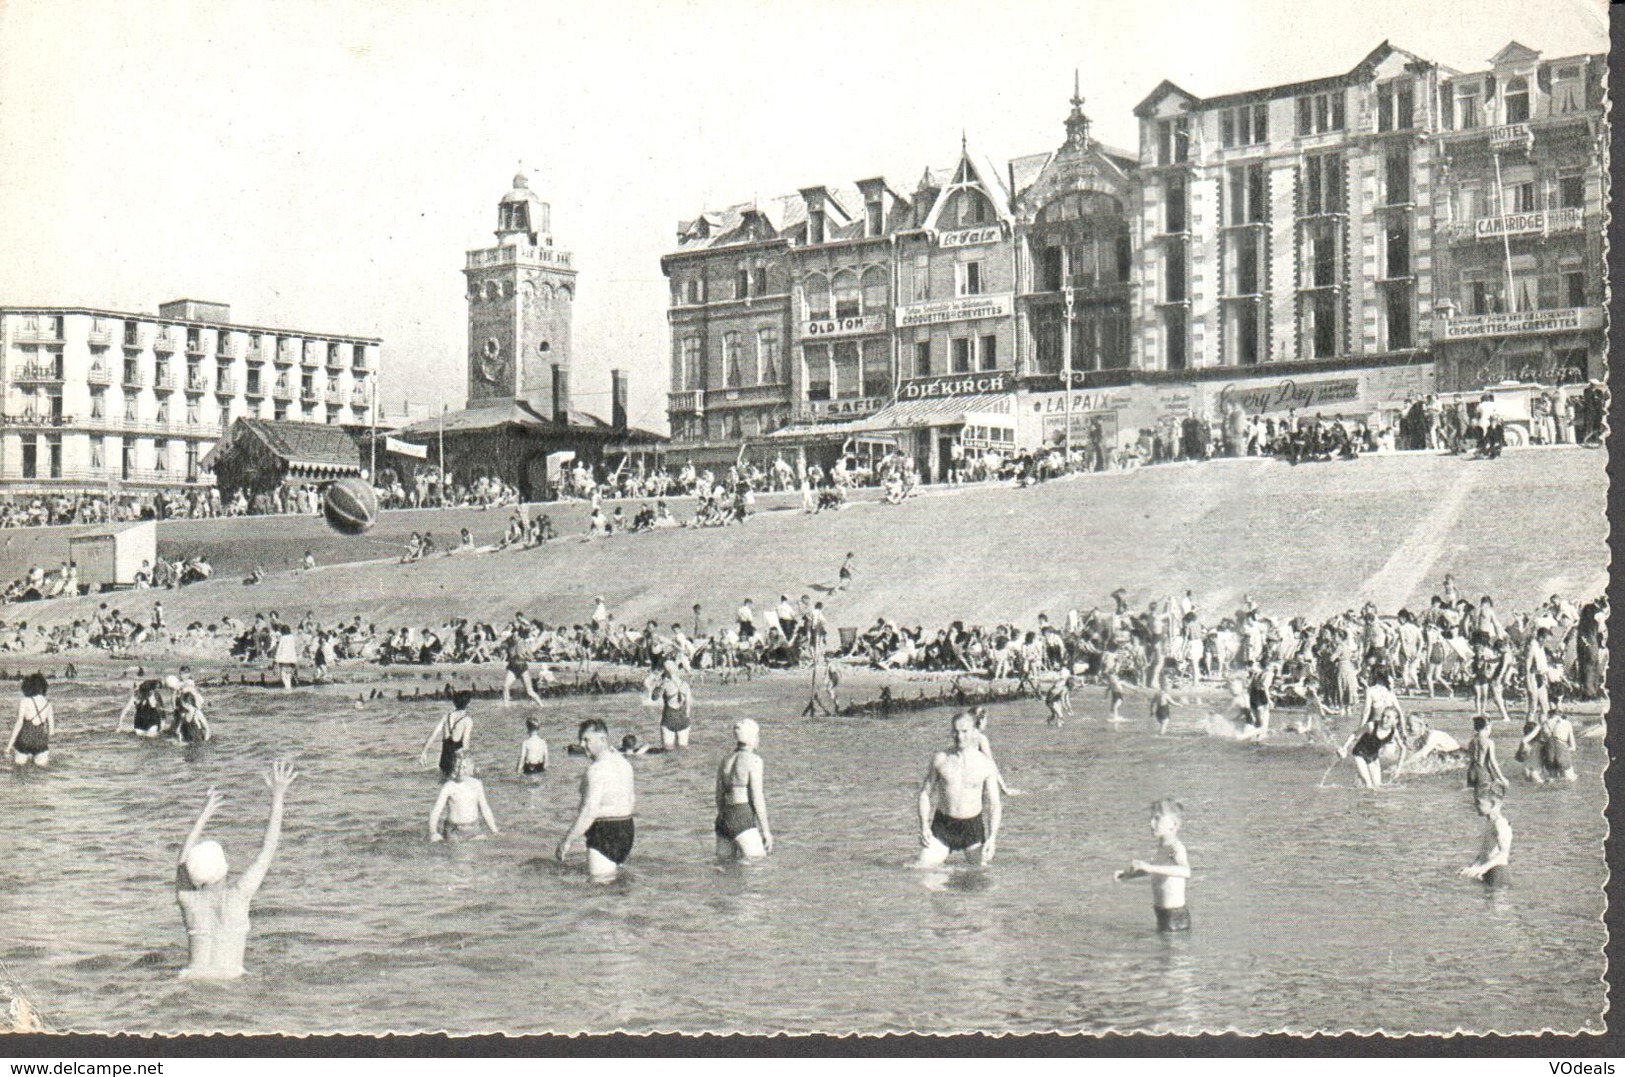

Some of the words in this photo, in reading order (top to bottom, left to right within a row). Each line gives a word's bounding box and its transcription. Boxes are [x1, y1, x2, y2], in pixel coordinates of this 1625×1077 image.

[1489, 124, 1526, 140] HOTEL
[1477, 214, 1543, 234] CAMBRIDGE
[957, 306, 1002, 319] CREVETTES
[809, 322, 835, 335] OLD
[838, 318, 864, 330] TOM
[1448, 323, 1509, 336] CROQUETTES
[1522, 318, 1578, 331] CREVETTES
[907, 377, 1004, 398] DIEKIRCH
[1274, 379, 1315, 408] Day
[827, 399, 883, 415] SAFIR
[1046, 397, 1065, 413] LA
[1072, 393, 1110, 410] PAIX
